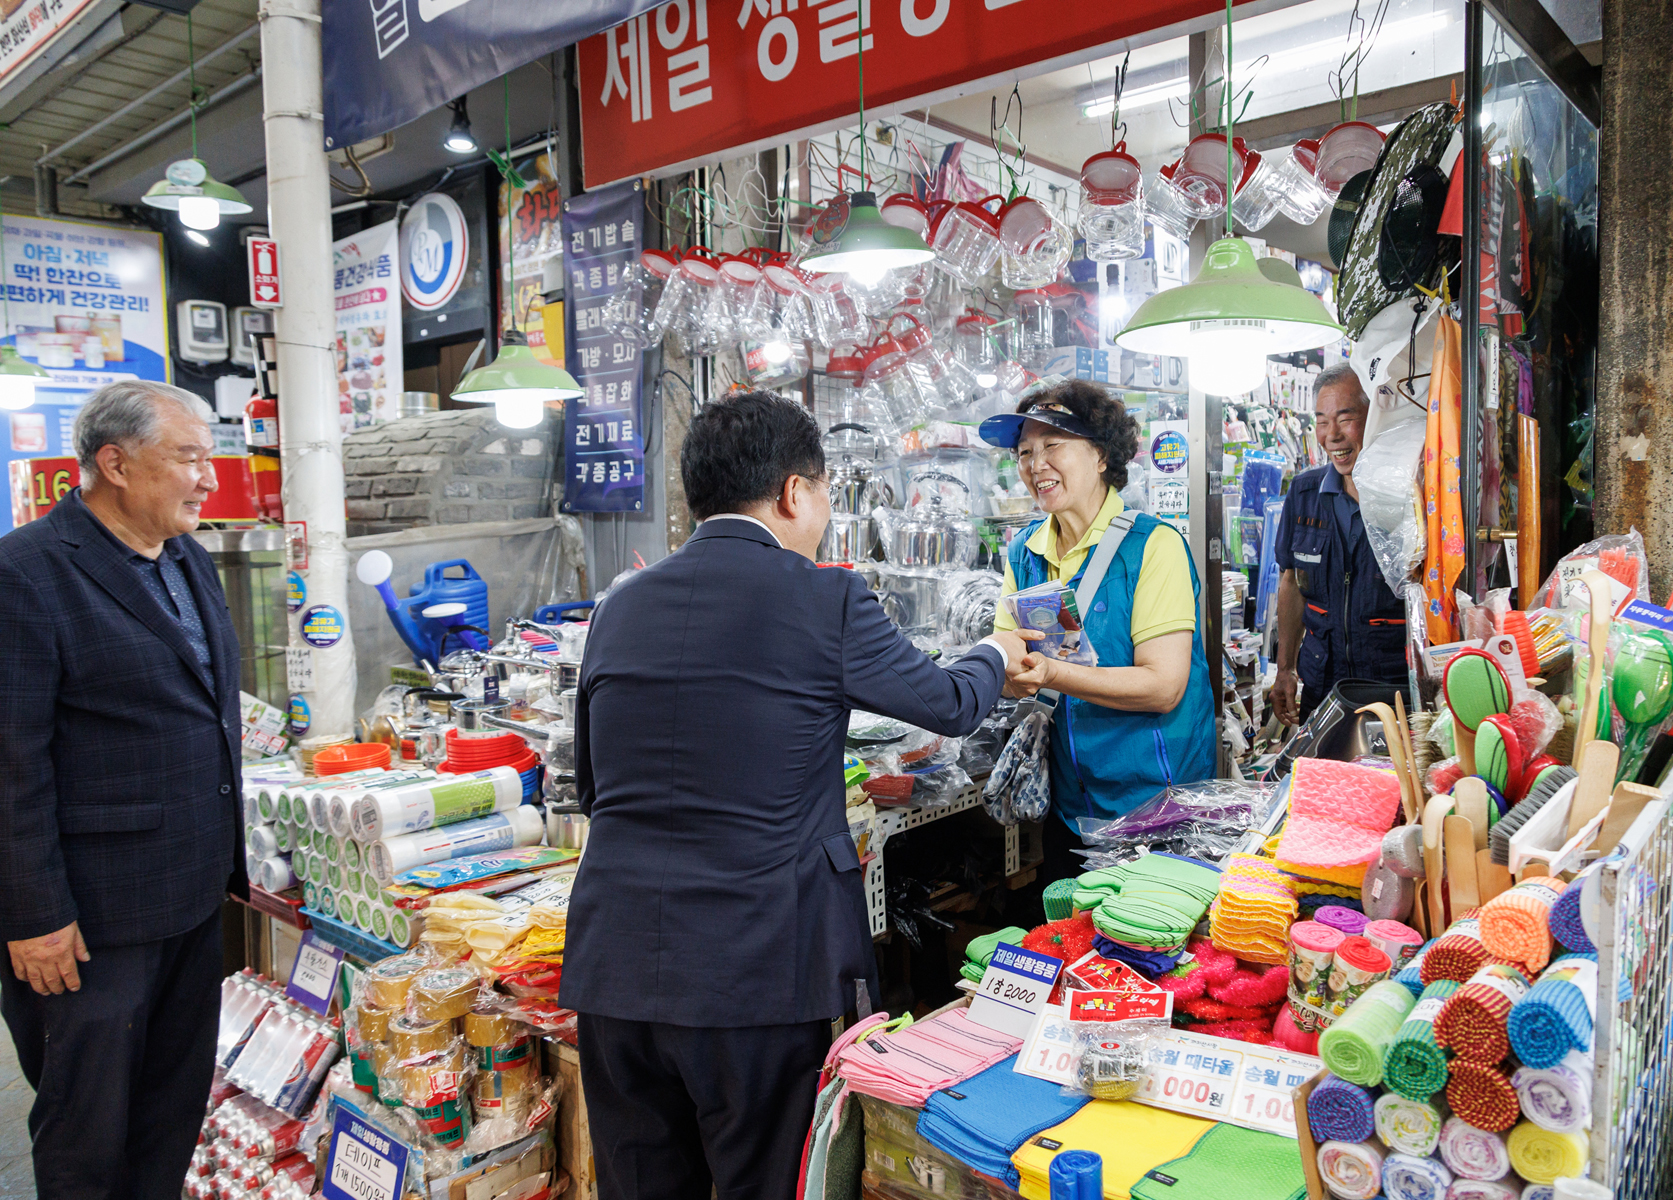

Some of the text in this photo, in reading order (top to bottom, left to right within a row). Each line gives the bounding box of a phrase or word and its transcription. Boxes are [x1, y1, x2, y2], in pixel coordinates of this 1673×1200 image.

[600, 0, 1022, 122] 제일 생활
[572, 219, 634, 253] 전기밥솥
[14, 264, 122, 290] 딱! 한잔으로
[71, 290, 149, 312] 건강관리!
[575, 300, 638, 331] 빨래대
[575, 420, 634, 446] 전기재료
[575, 459, 635, 483] 각종공구
[35, 469, 72, 506] 16
[993, 948, 1059, 979] 제일생활용품
[1184, 1053, 1235, 1077] 때타올
[1245, 1065, 1281, 1087] 송월
[345, 1140, 382, 1179] 테이프
